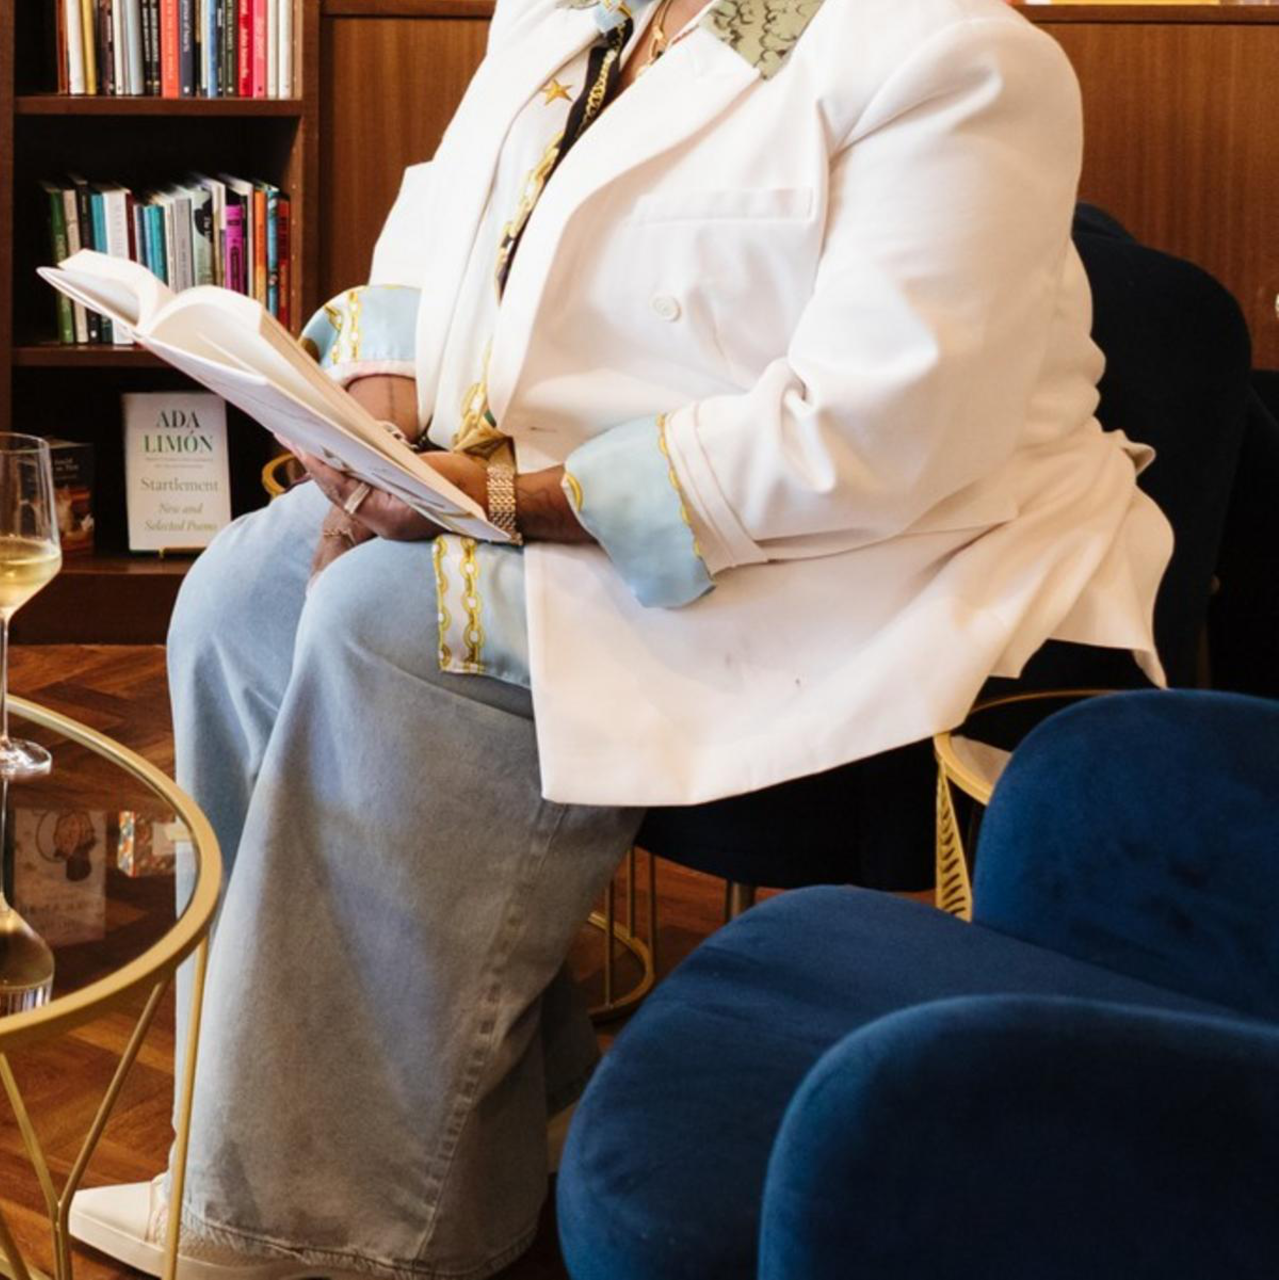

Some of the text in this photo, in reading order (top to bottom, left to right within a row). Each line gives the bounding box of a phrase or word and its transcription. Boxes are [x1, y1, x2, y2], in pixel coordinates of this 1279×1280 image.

[156, 410, 200, 429] ADA
[144, 430, 213, 452] LIMÓN
[140, 477, 219, 492] Startlement
[185, 503, 203, 514] and
[144, 519, 186, 531] Selected
